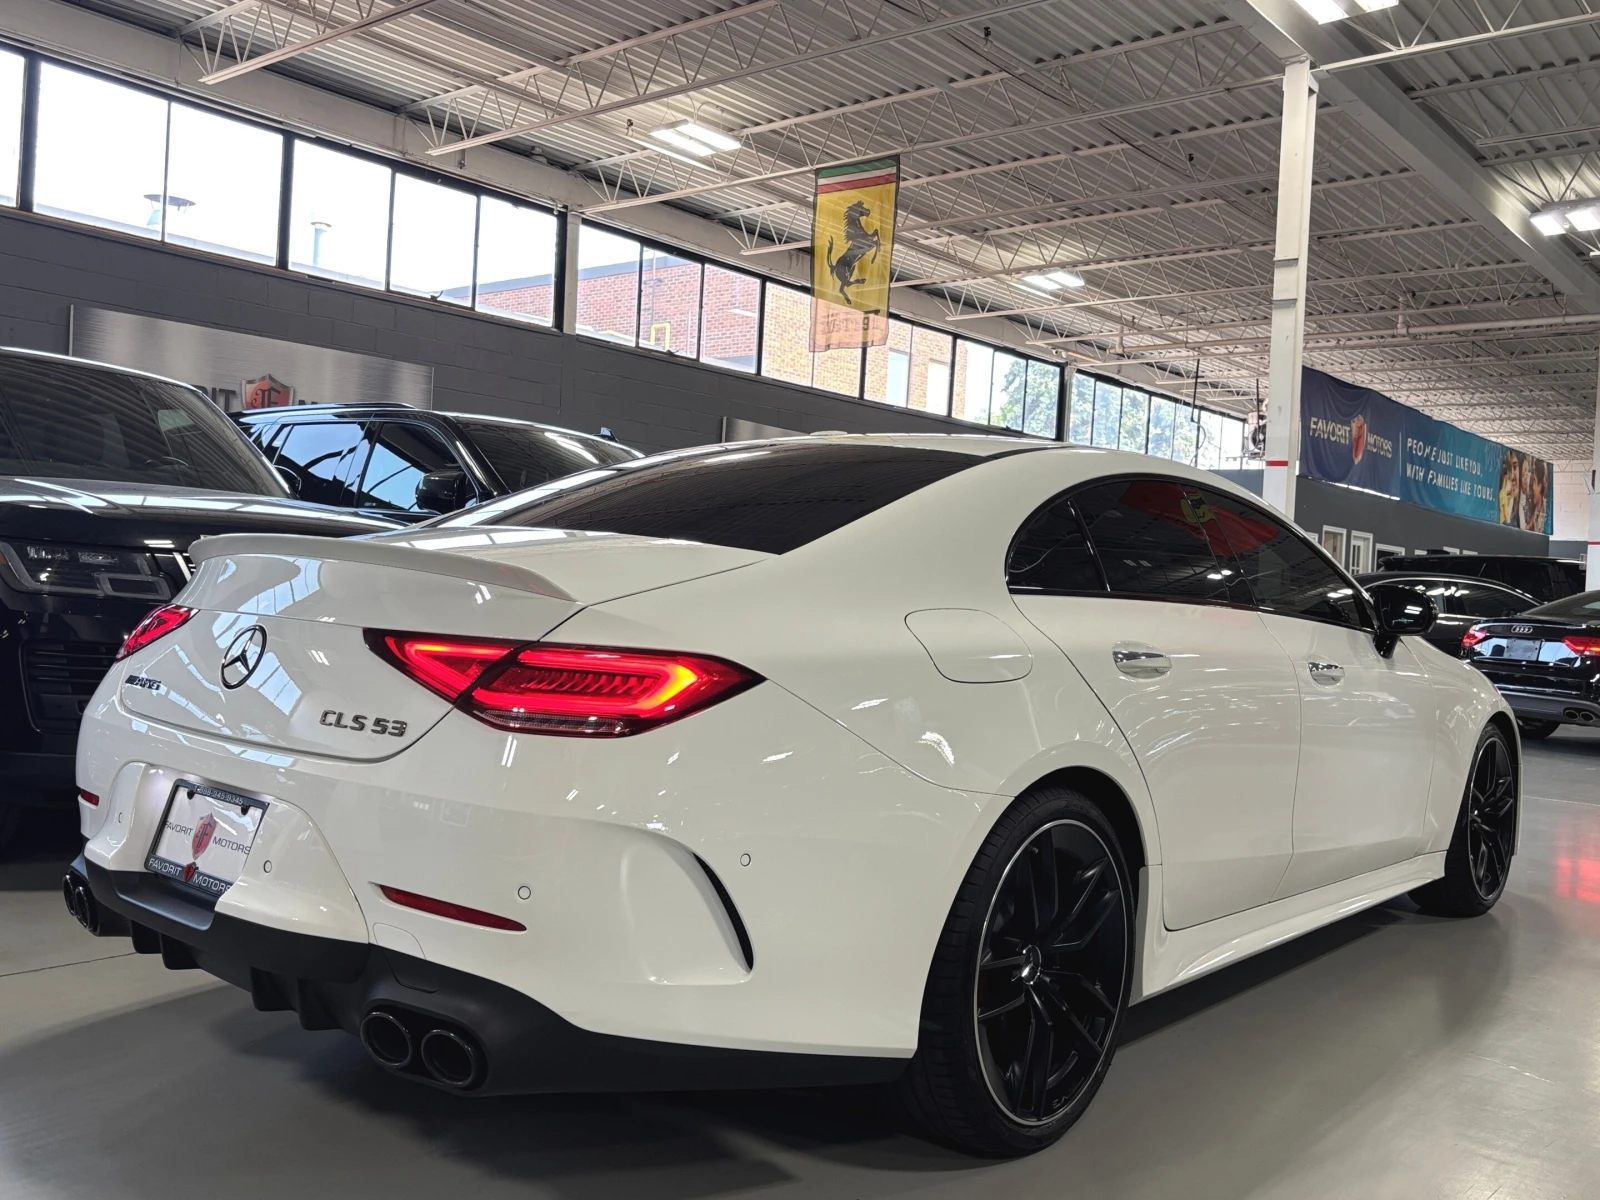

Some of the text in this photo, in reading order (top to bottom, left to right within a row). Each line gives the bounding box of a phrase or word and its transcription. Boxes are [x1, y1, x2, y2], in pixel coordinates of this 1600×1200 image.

[1309, 417, 1393, 459] FAVORIT MOTORS
[1437, 449, 1454, 467] JUST
[1455, 455, 1469, 472] LIKE
[1469, 459, 1484, 478] YOU,
[1427, 469, 1459, 492] FAMILIES
[319, 708, 408, 738] CLS 53
[165, 821, 252, 855] FAVORIT MOTORS
[148, 858, 231, 893] FAVORIT MOTORS
